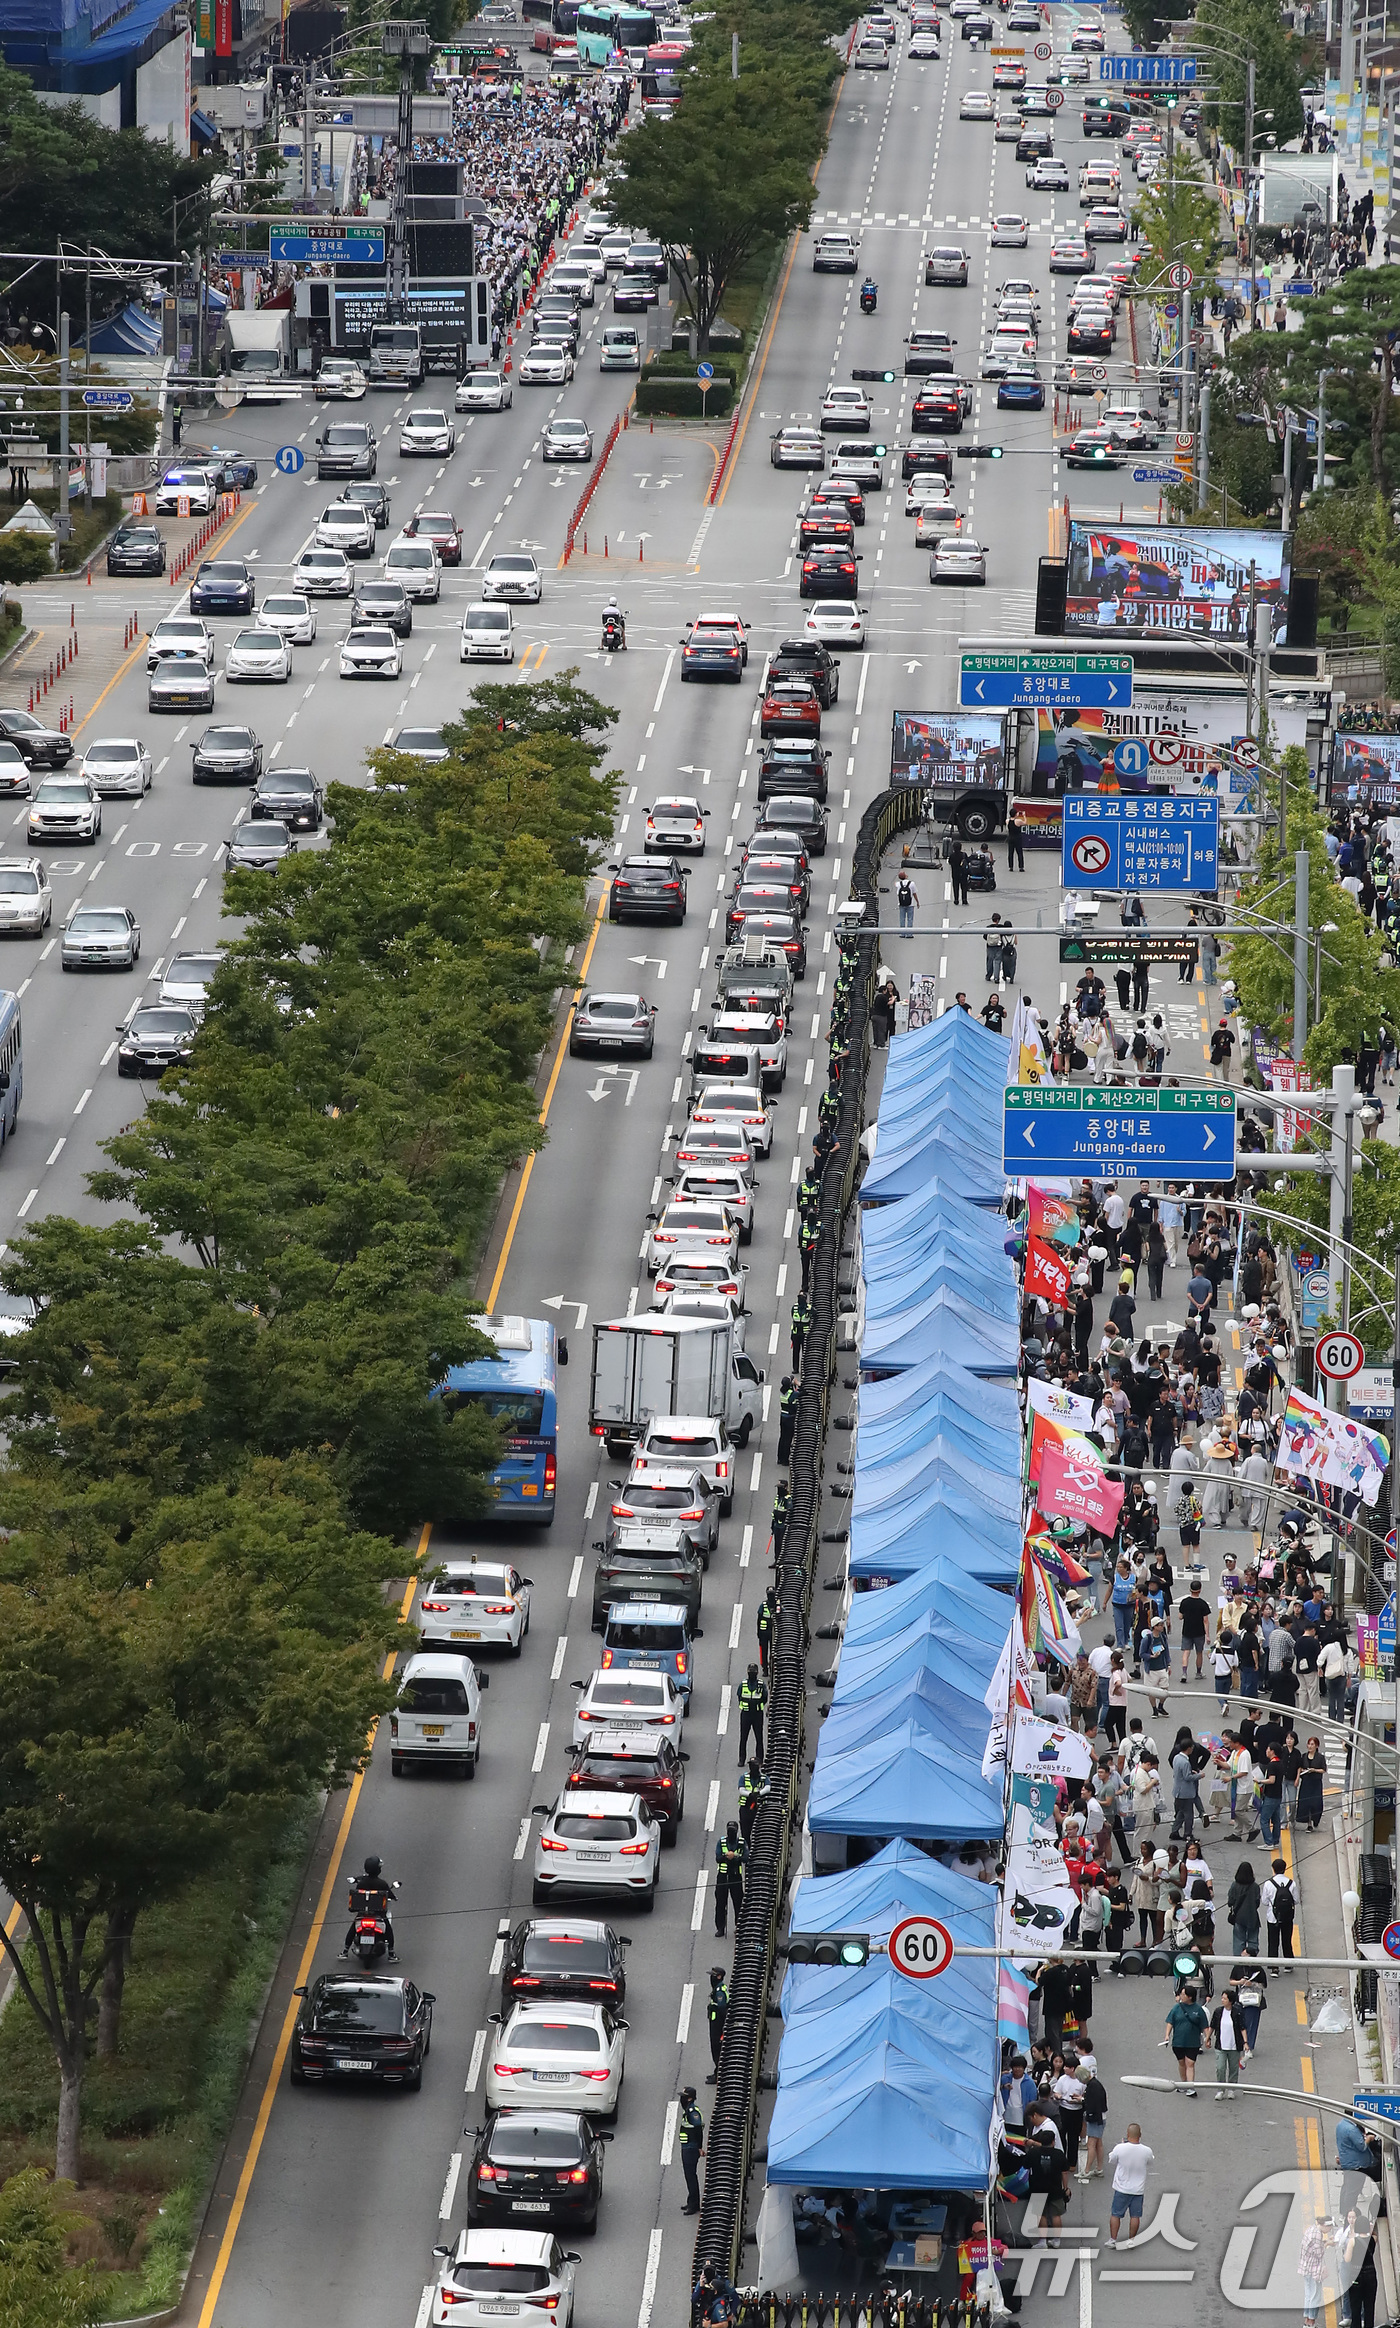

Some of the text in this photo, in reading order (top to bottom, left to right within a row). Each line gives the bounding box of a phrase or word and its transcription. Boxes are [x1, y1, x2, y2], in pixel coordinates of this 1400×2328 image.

[1038, 46, 1048, 57] 60
[1049, 93, 1060, 105] 60
[353, 229, 376, 237] 대구역
[311, 241, 343, 251] 중앙대로
[304, 252, 350, 260] Jungang-daero
[975, 657, 1016, 668] 명덕네거리
[1031, 658, 1075, 670] 계산오거리
[1086, 659, 1119, 670] 대구역
[1022, 677, 1071, 692] 중앙대로
[1012, 693, 1081, 704] Jungang-daero
[1069, 800, 1213, 819] 대중교통전용지구
[1126, 827, 1171, 839] 시내버스
[1193, 850, 1215, 863] 허용
[1125, 858, 1182, 870] 이륜자동차
[1125, 873, 1160, 885] 자전거
[1022, 1091, 1077, 1105] 명덕네거리
[1100, 1093, 1156, 1107] 계산오거리
[1174, 1094, 1218, 1108] 대구역
[1086, 1119, 1152, 1139] 중앙대로
[1073, 1141, 1166, 1155] Jungang-daero
[1100, 1163, 1137, 1176] 150m
[1327, 1345, 1352, 1367] 60
[1054, 1488, 1105, 1517] 모두의 결혼
[903, 1933, 939, 1963] 60
[554, 2073, 568, 2081] 1693
[1369, 2102, 1393, 2114] 대구
[500, 2305, 517, 2313] 9888
